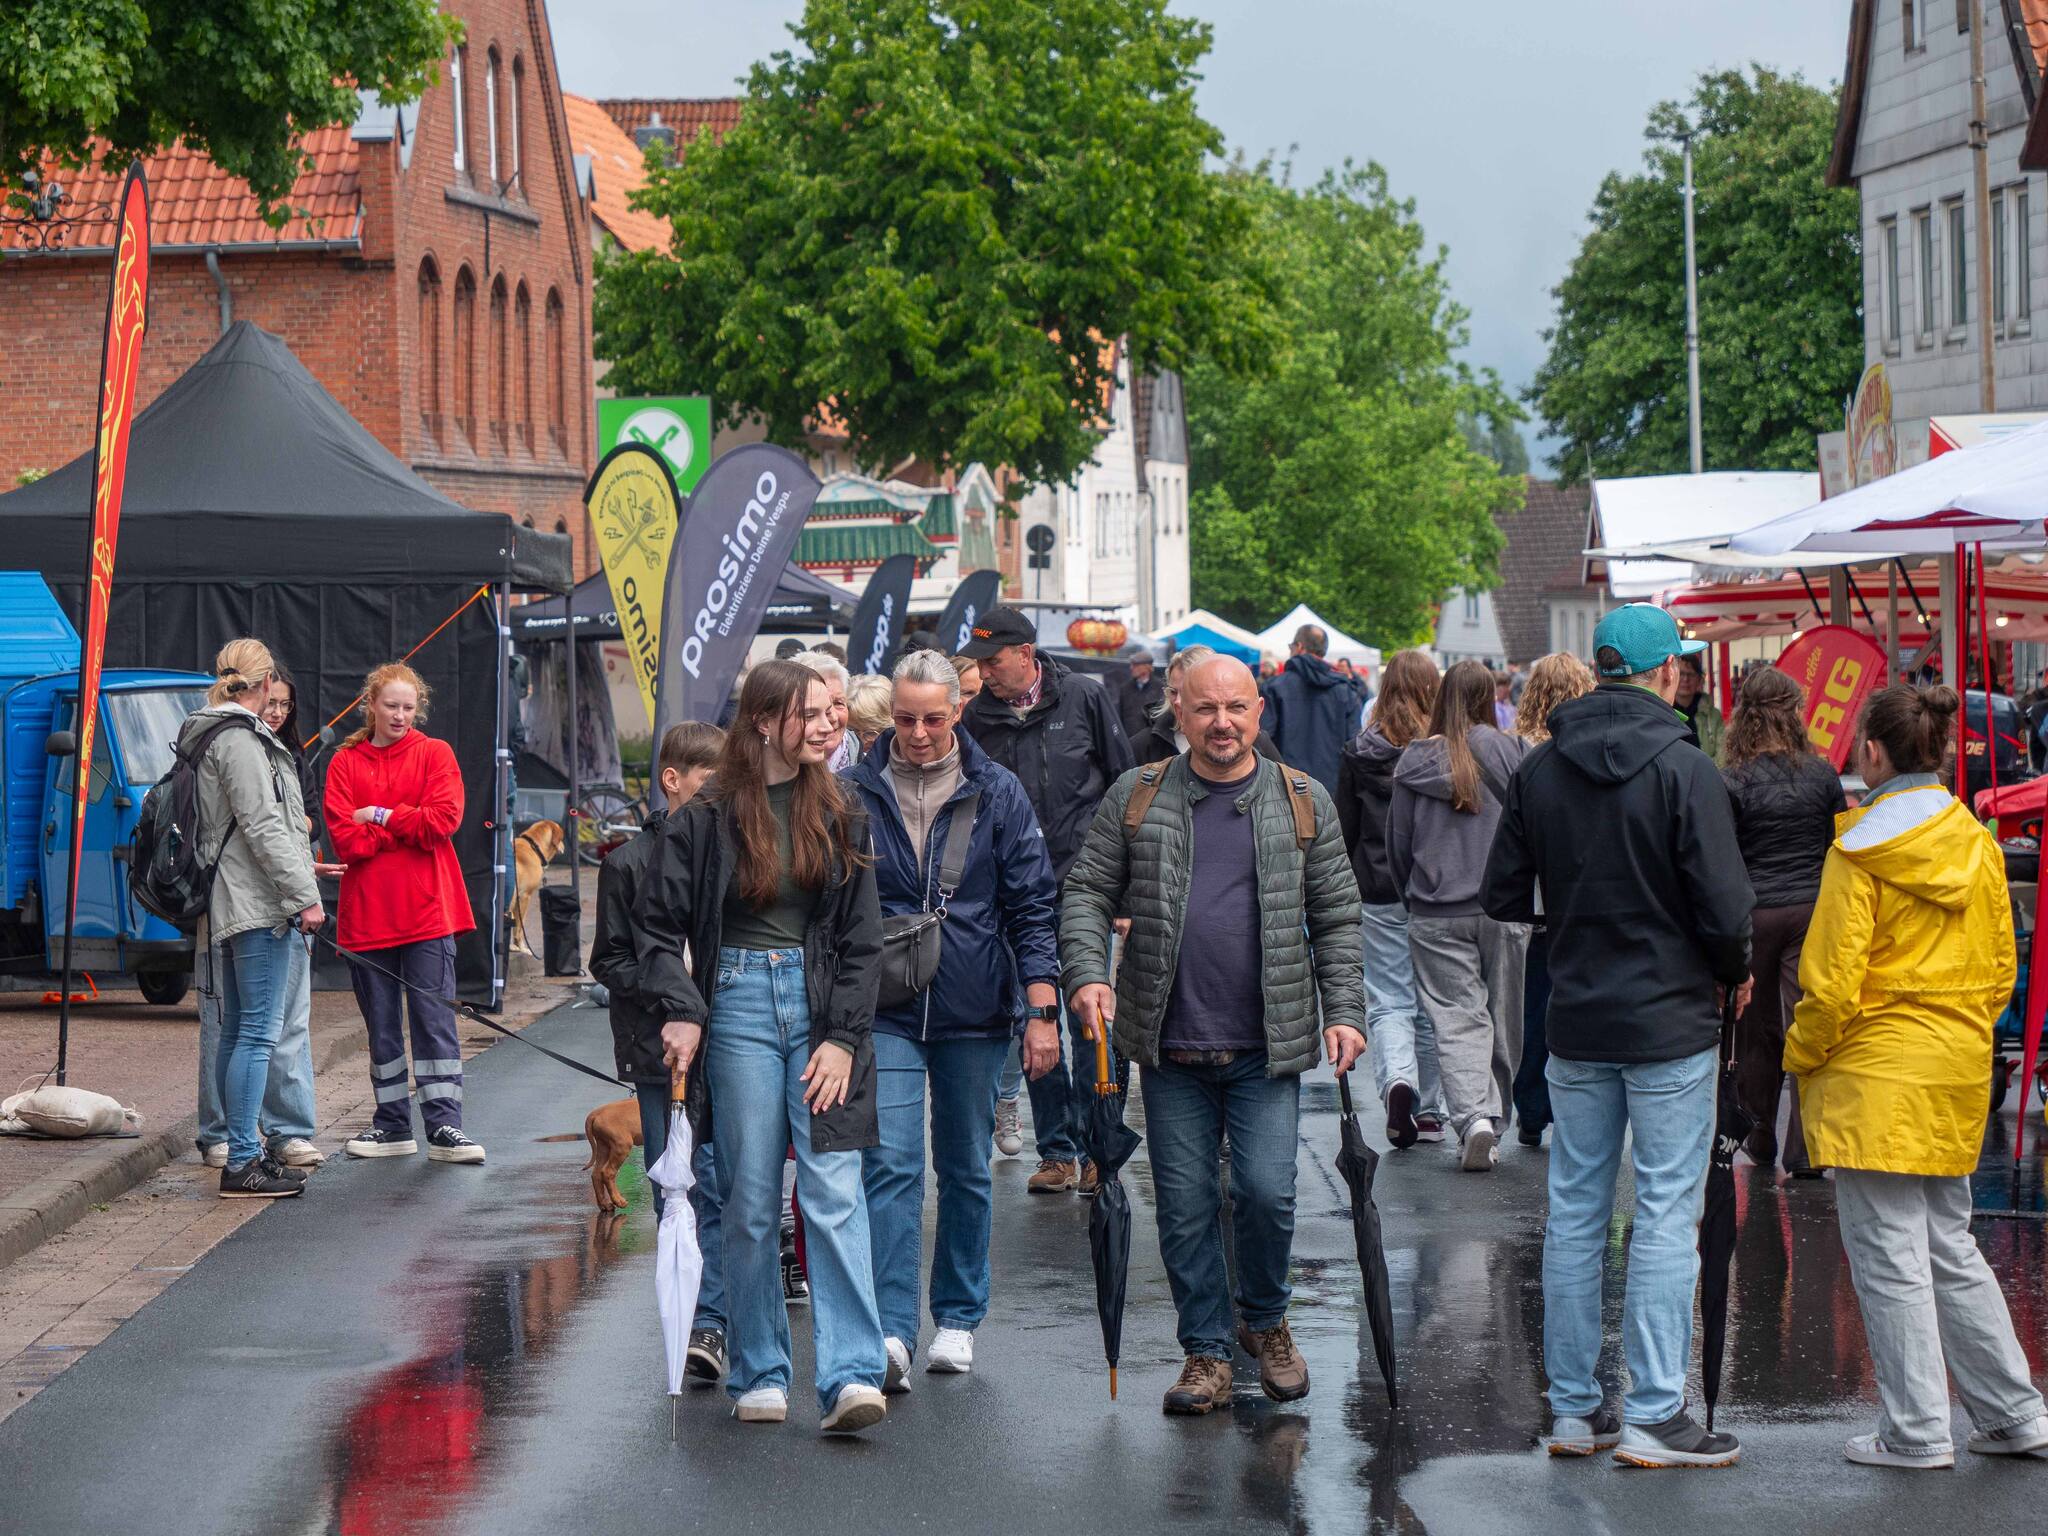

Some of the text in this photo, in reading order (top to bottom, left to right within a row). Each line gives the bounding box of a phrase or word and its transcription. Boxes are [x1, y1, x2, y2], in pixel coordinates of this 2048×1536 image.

[718, 490, 792, 636] Elektrifiziere Deine Vespa.
